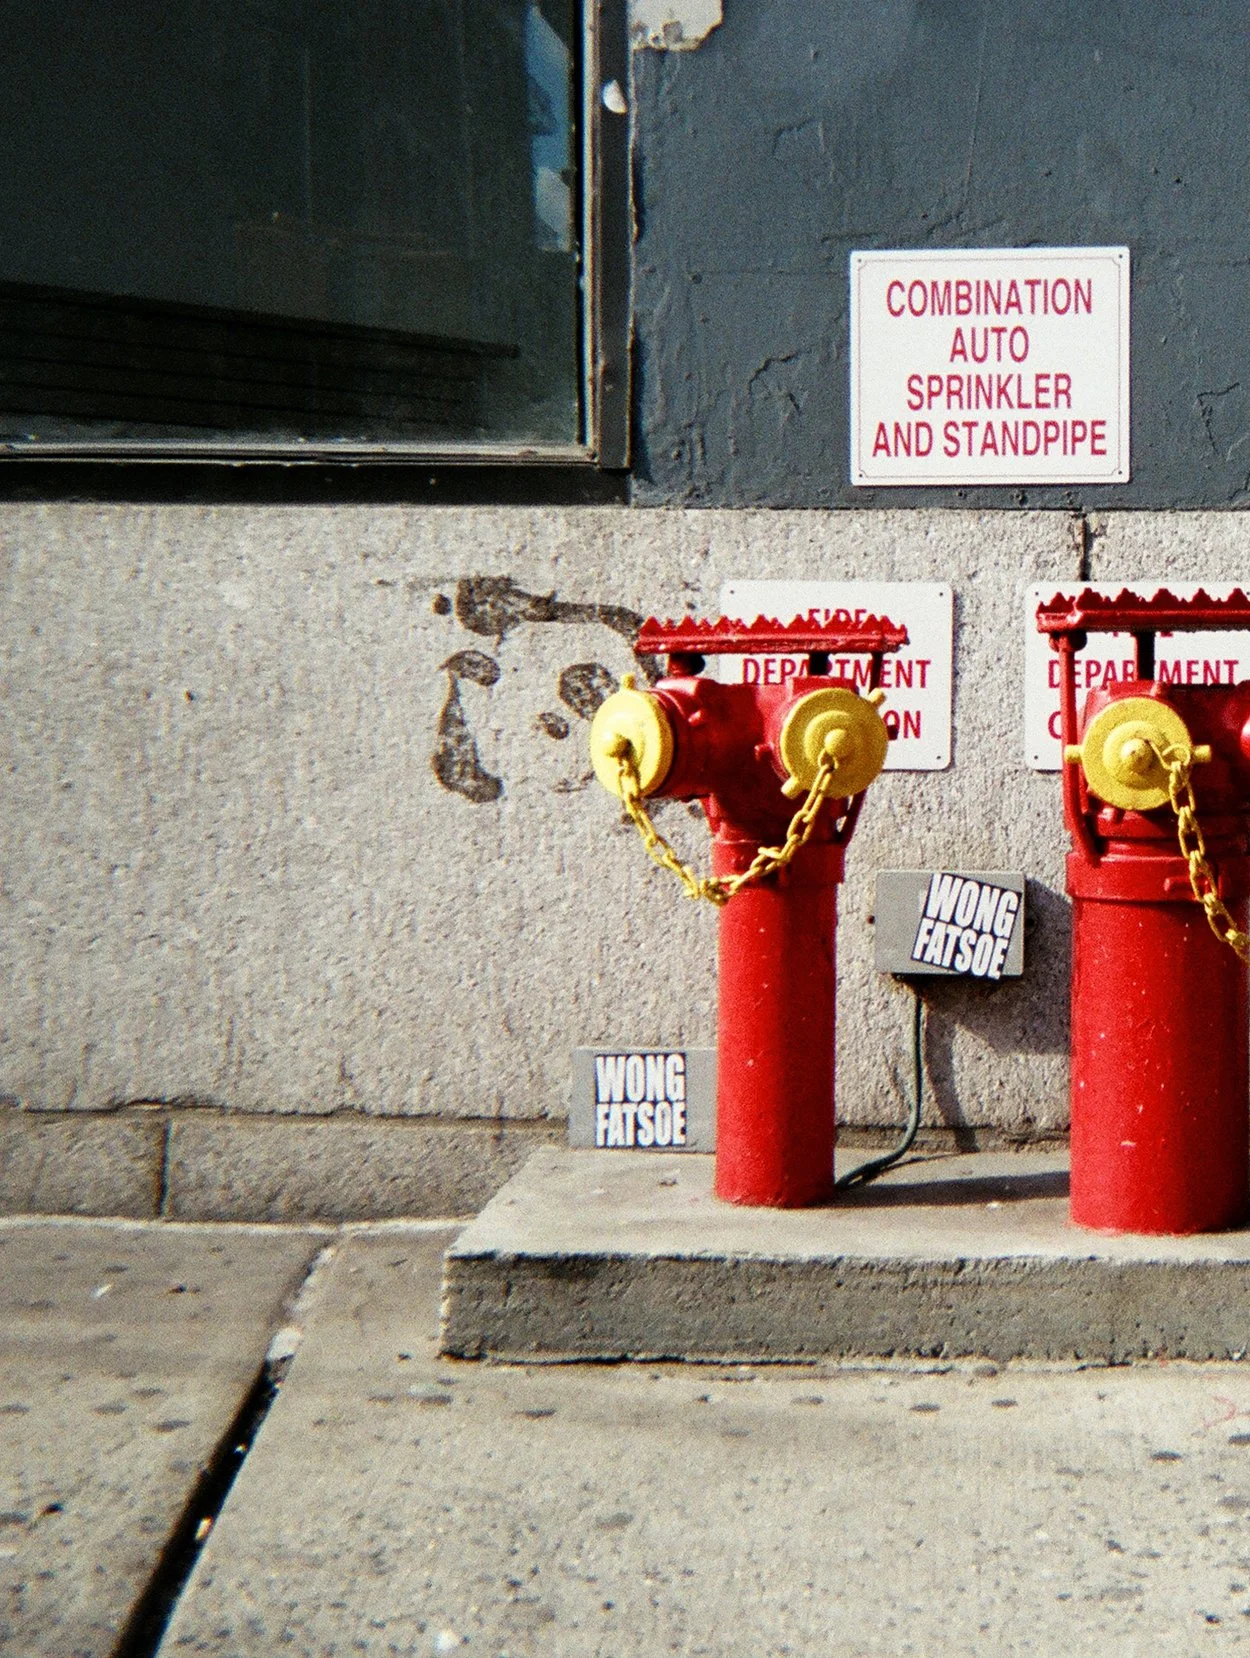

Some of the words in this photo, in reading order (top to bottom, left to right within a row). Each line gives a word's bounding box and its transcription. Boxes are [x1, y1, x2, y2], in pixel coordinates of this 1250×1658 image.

[886, 278, 1093, 317] COMBINATION
[949, 326, 1030, 364] AUTO
[907, 373, 1073, 411] SPRINKLER
[872, 421, 933, 457] AND
[943, 419, 1107, 457] STANDPIPE
[1048, 659, 1239, 689] DEPARMENT
[926, 873, 1018, 939] WONG
[912, 917, 1010, 980] FATSOE
[596, 1053, 686, 1103] WONG
[596, 1100, 686, 1147] FATSOE
